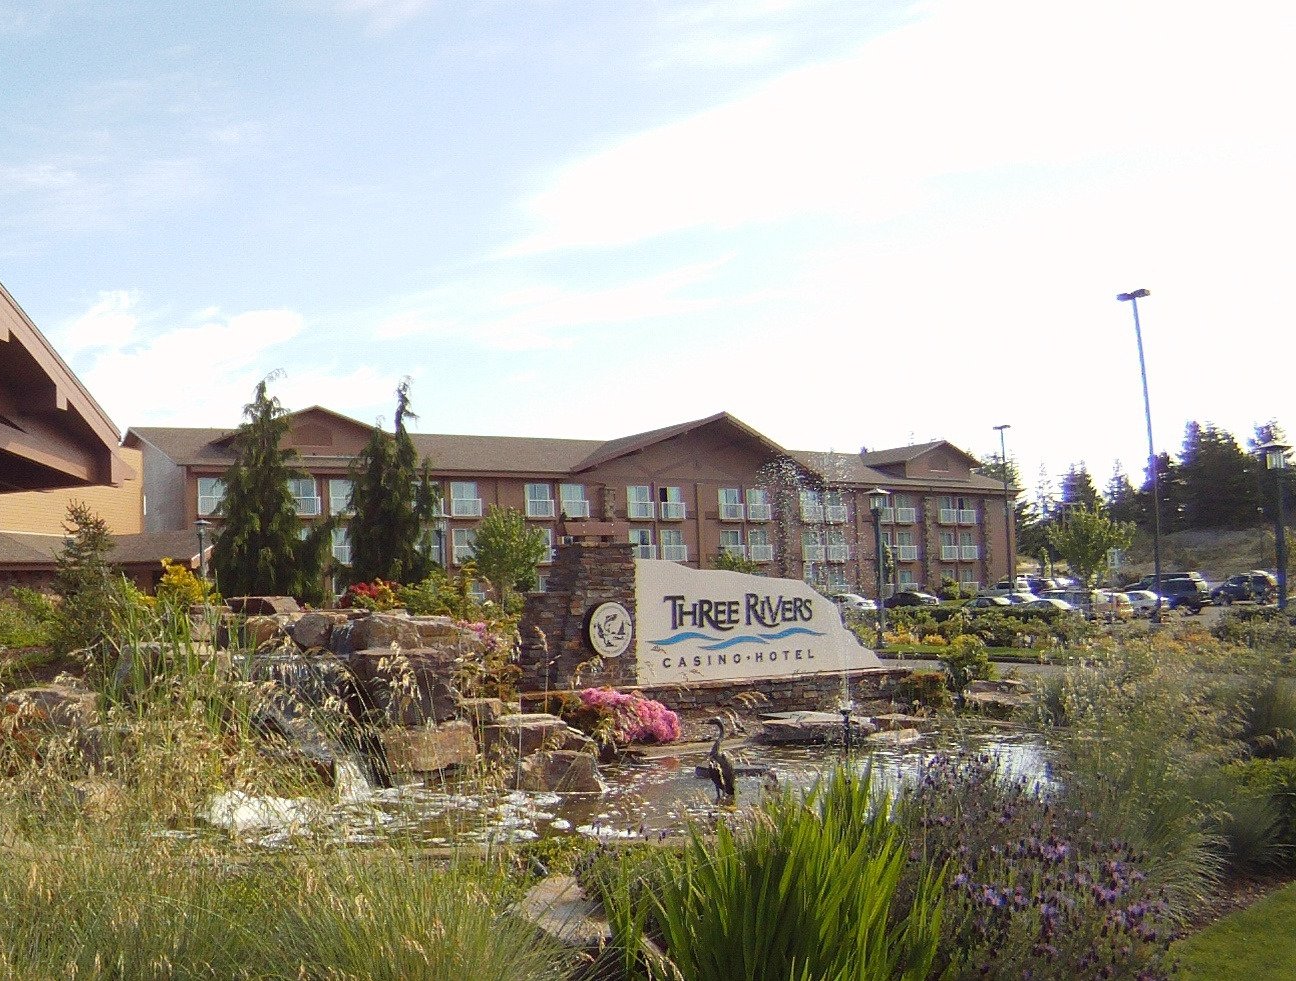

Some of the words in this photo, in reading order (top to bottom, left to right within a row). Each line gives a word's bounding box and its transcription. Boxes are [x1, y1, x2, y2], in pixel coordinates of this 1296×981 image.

[663, 595, 740, 631] THREE
[745, 593, 813, 628] RIVERS
[662, 653, 742, 668] CASINO
[755, 649, 815, 662] HOTEL
